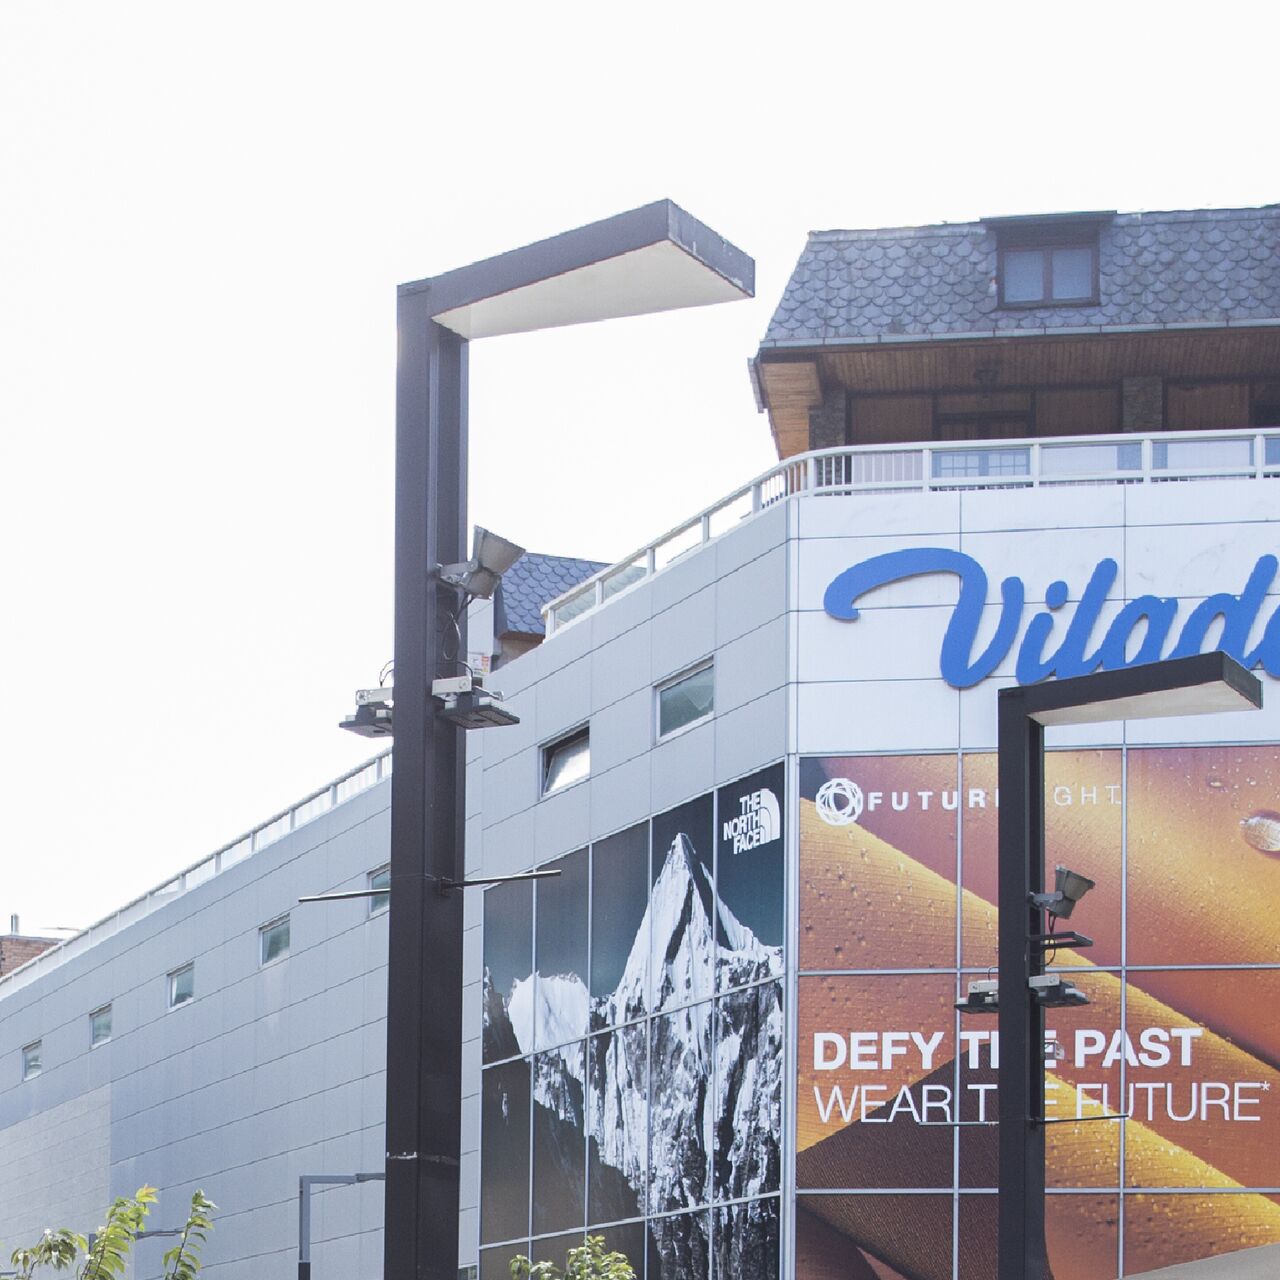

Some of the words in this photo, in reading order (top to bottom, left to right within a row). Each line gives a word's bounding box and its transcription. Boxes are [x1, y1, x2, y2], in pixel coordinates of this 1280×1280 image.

[739, 791, 761, 814] THE
[867, 786, 1121, 811] FUTURGHT
[723, 808, 760, 841] NORTH
[733, 829, 761, 855] FACE
[814, 1031, 944, 1070] DEFY
[960, 1029, 1061, 1070] TE
[1075, 1027, 1204, 1068] PAST
[814, 1083, 952, 1122] WEAR
[967, 1083, 1060, 1122] TE
